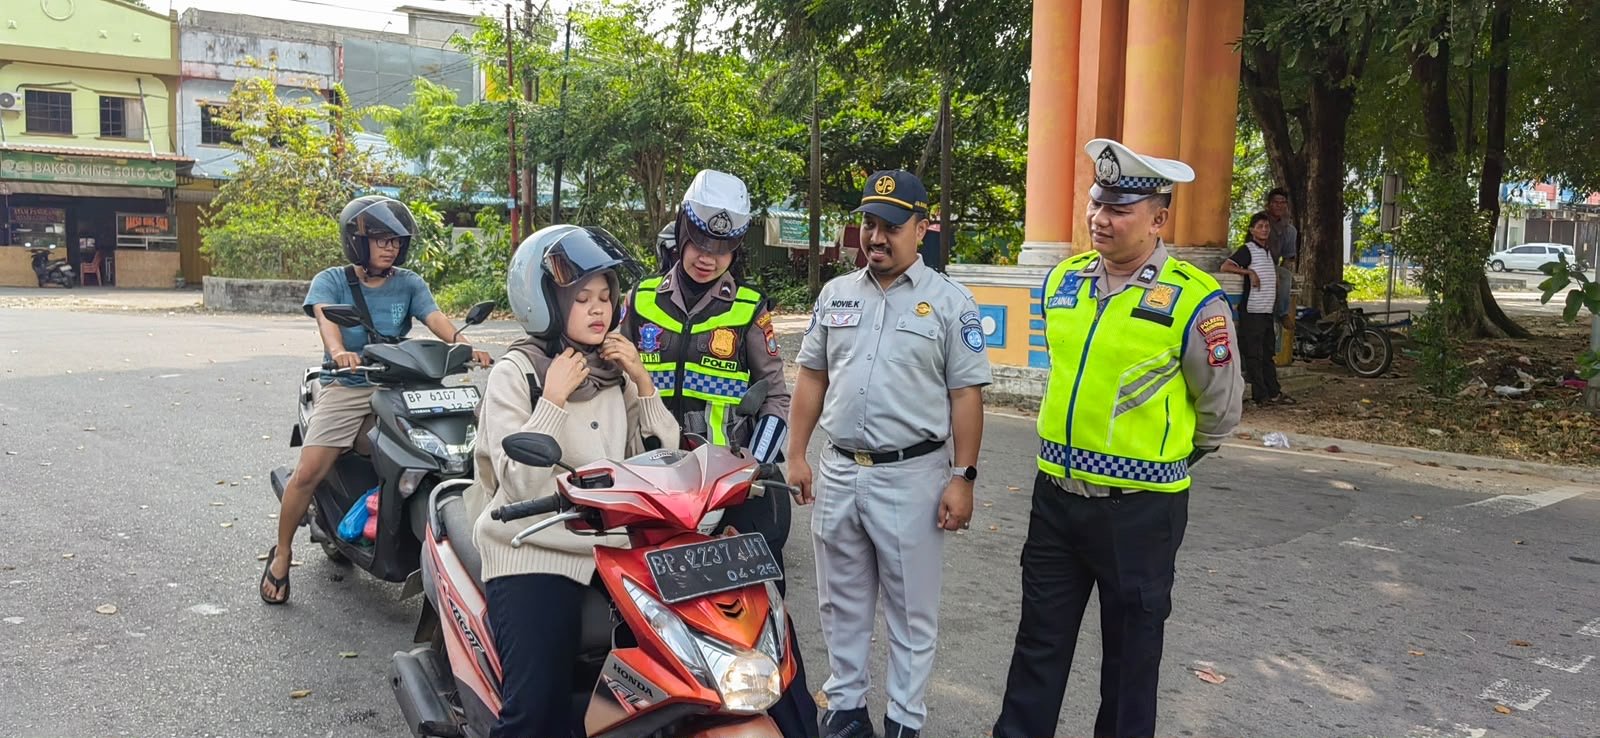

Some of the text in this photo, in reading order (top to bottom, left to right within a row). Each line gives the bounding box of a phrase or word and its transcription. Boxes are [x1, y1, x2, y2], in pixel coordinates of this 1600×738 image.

[34, 162, 145, 178] BAKSO KING SOLO
[703, 357, 735, 370] POLRI
[407, 393, 422, 403] BP
[429, 390, 456, 401] 6107
[686, 543, 732, 569] 2237
[613, 663, 653, 698] HONDA
